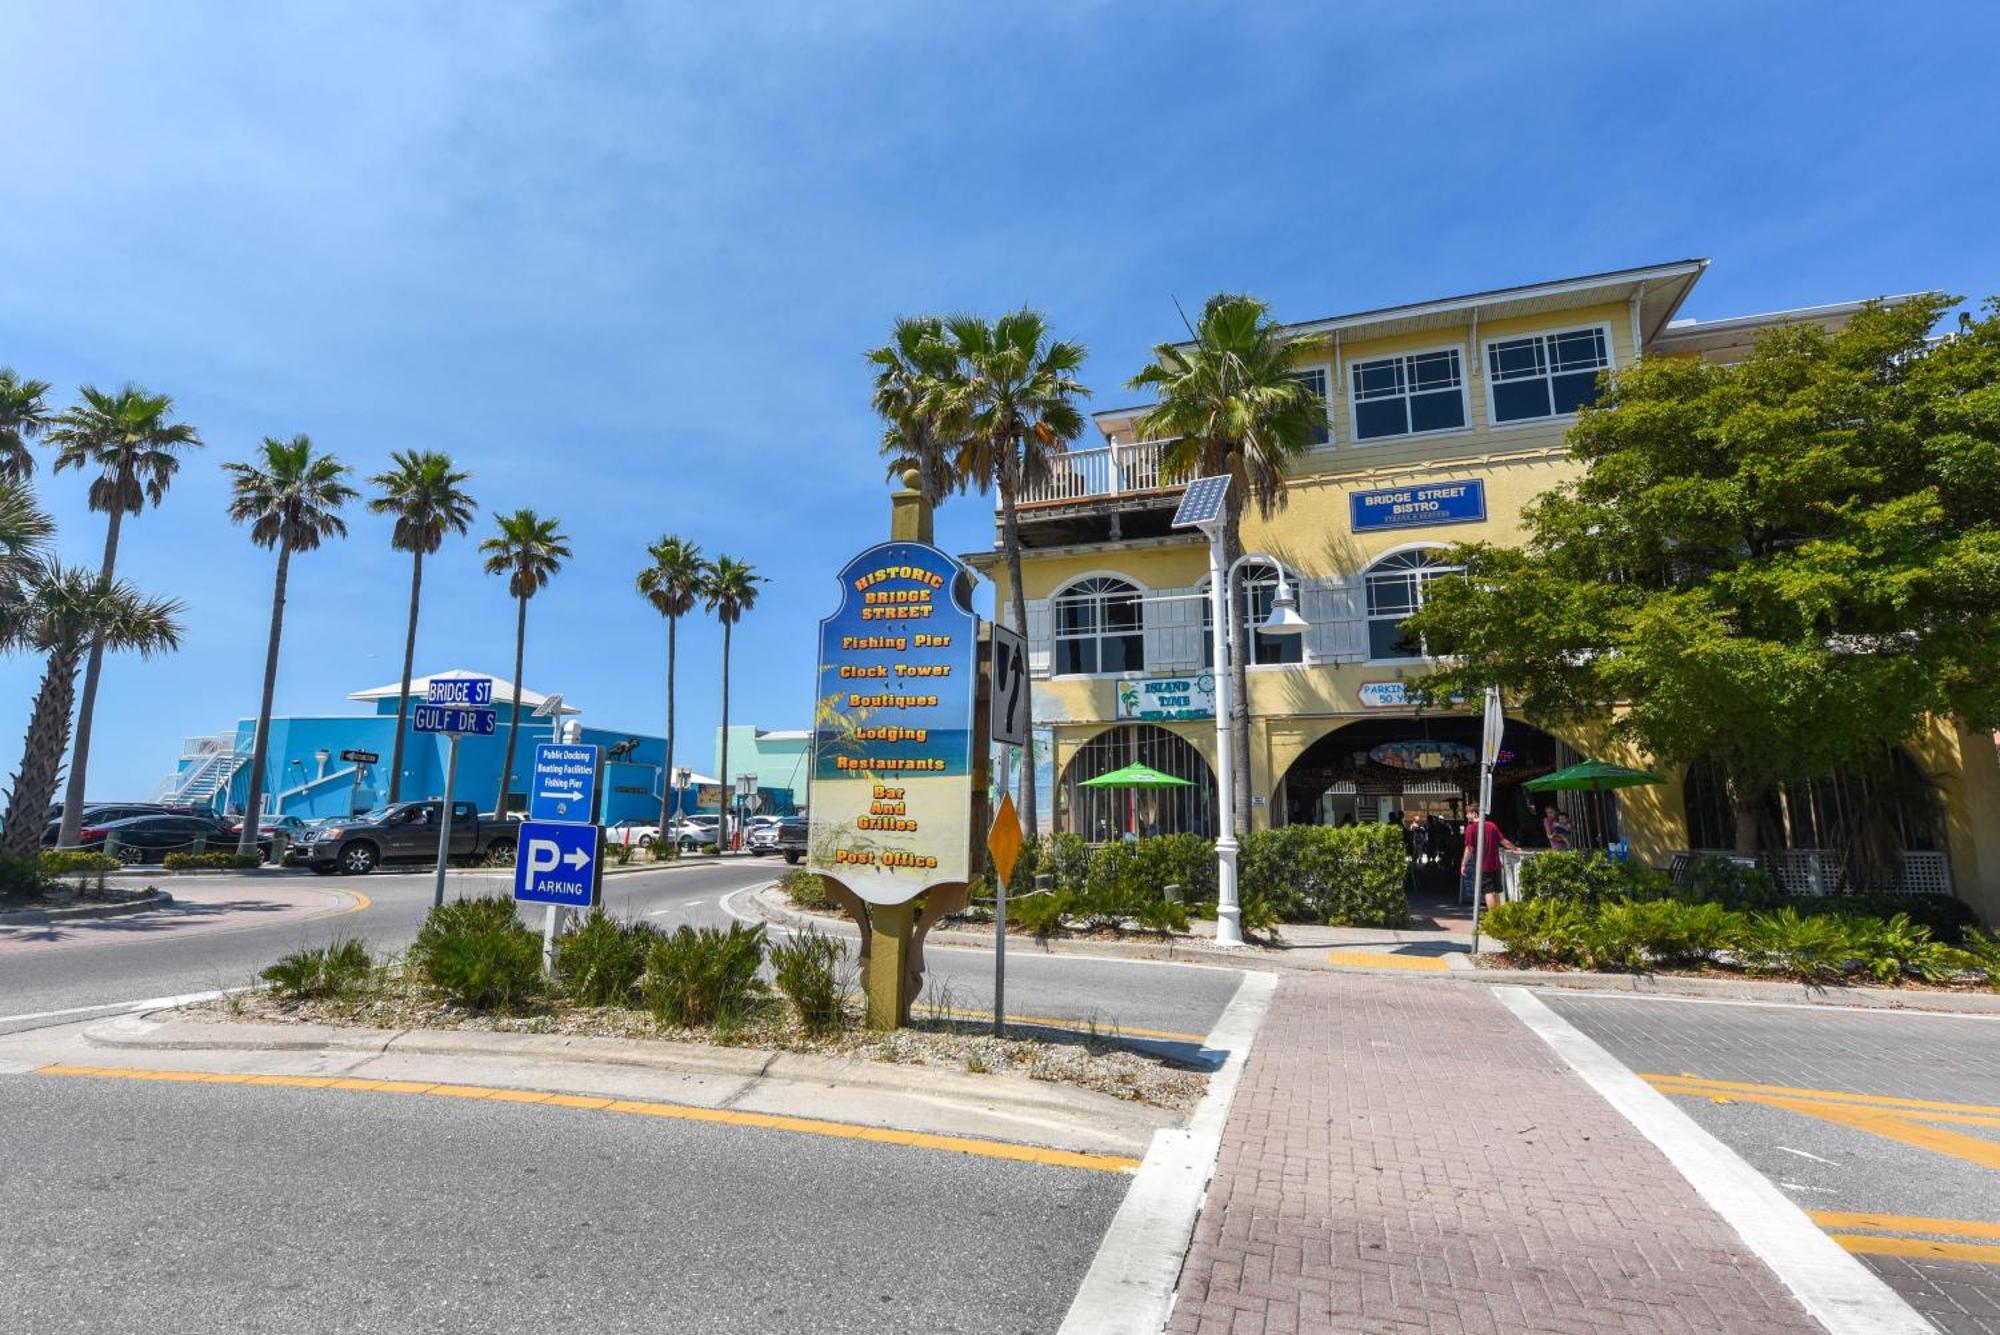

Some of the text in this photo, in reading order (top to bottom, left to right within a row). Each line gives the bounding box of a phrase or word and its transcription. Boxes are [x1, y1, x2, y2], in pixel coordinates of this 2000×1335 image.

[1365, 487, 1466, 506] BRIDGE STREET
[1392, 501, 1439, 514] BISTRO
[855, 566, 944, 592] HISTORIC
[865, 589, 931, 604] BRIDGE
[862, 605, 933, 620] STREET
[842, 634, 951, 651] Fishing Pier
[840, 664, 950, 678] Clock Tower
[429, 682, 491, 702] BRIDGE ST
[1145, 681, 1190, 693] ISLAND
[849, 694, 938, 709] Boutiques
[1158, 696, 1190, 706] TIME
[415, 709, 452, 729] GULF
[486, 714, 494, 732] S
[856, 727, 927, 743] Lodging
[543, 750, 590, 762] Public Docking
[537, 763, 593, 775] Boating Facilities
[836, 757, 945, 771] Restaurants
[544, 777, 583, 790] Fishing Pier
[873, 785, 905, 799] Bar
[870, 801, 906, 815] And
[857, 815, 917, 831] Grilles
[836, 849, 937, 868] Post Office
